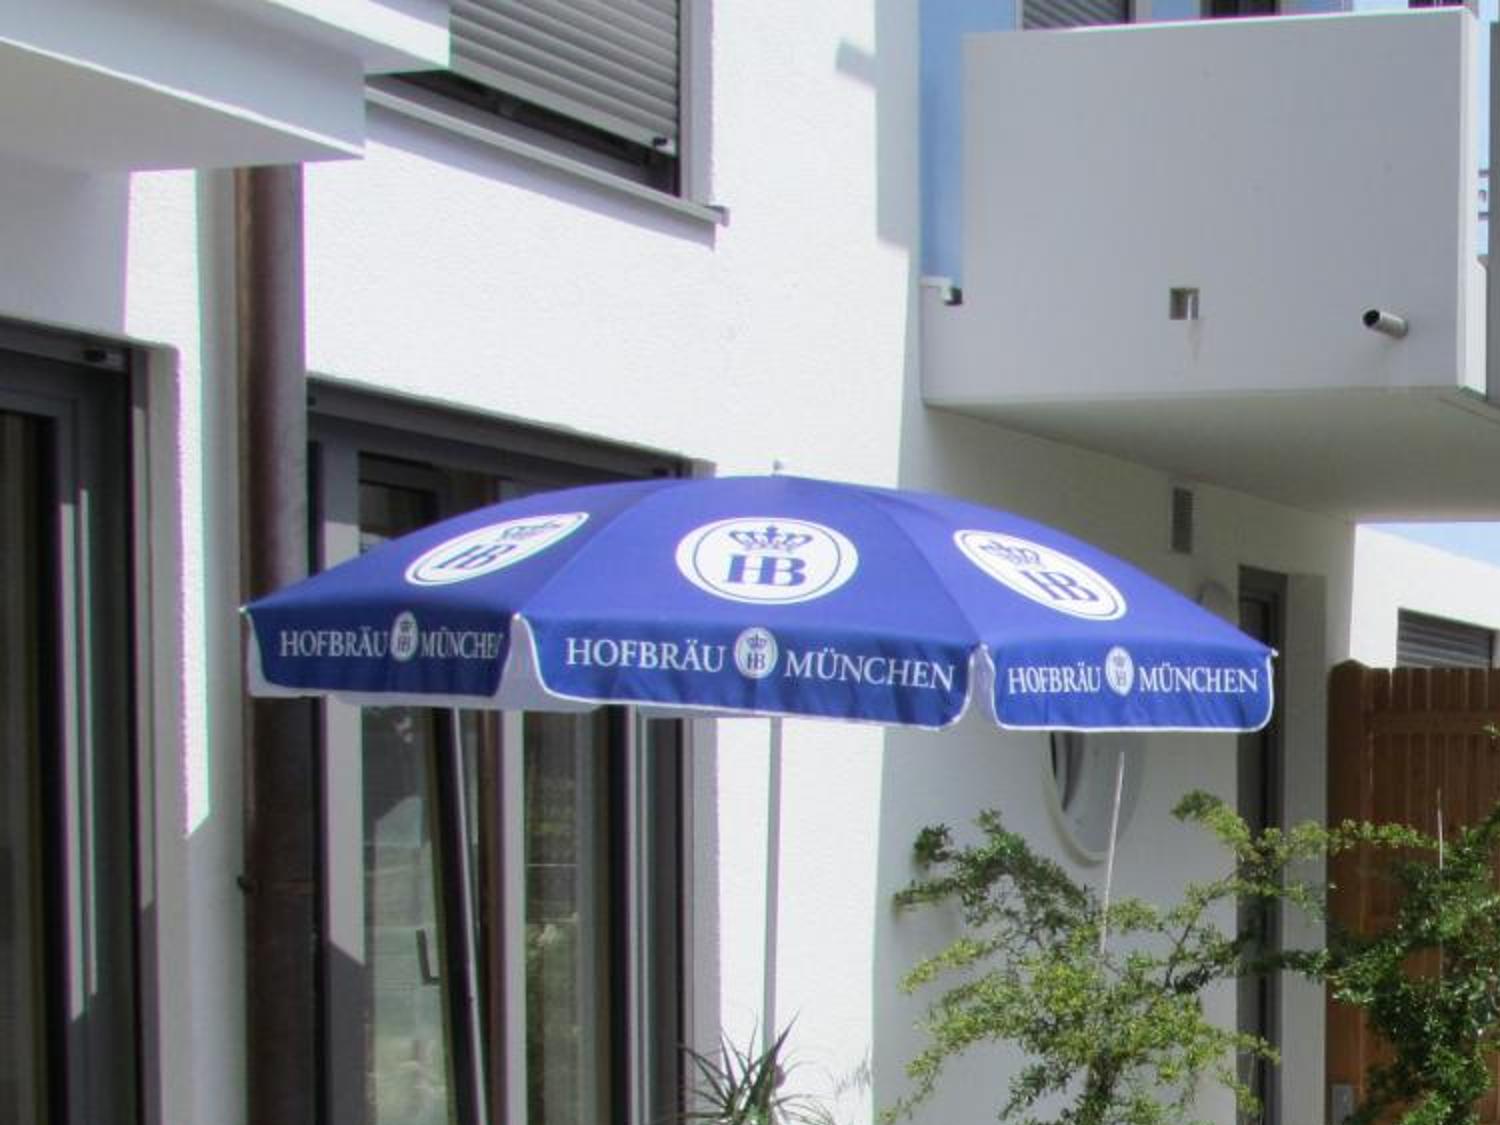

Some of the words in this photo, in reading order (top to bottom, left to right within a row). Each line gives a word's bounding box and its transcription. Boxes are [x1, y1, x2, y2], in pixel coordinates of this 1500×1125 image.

[432, 543, 517, 571] HB
[726, 553, 807, 587] HB
[1020, 570, 1100, 602] HB
[279, 625, 388, 658] HOFBRÄU
[566, 637, 726, 672] HOFBRÄU
[784, 647, 956, 691] MÜNCHEN
[1007, 661, 1101, 694] HOFBRÄU
[1138, 662, 1259, 692] MÜNCHEN
